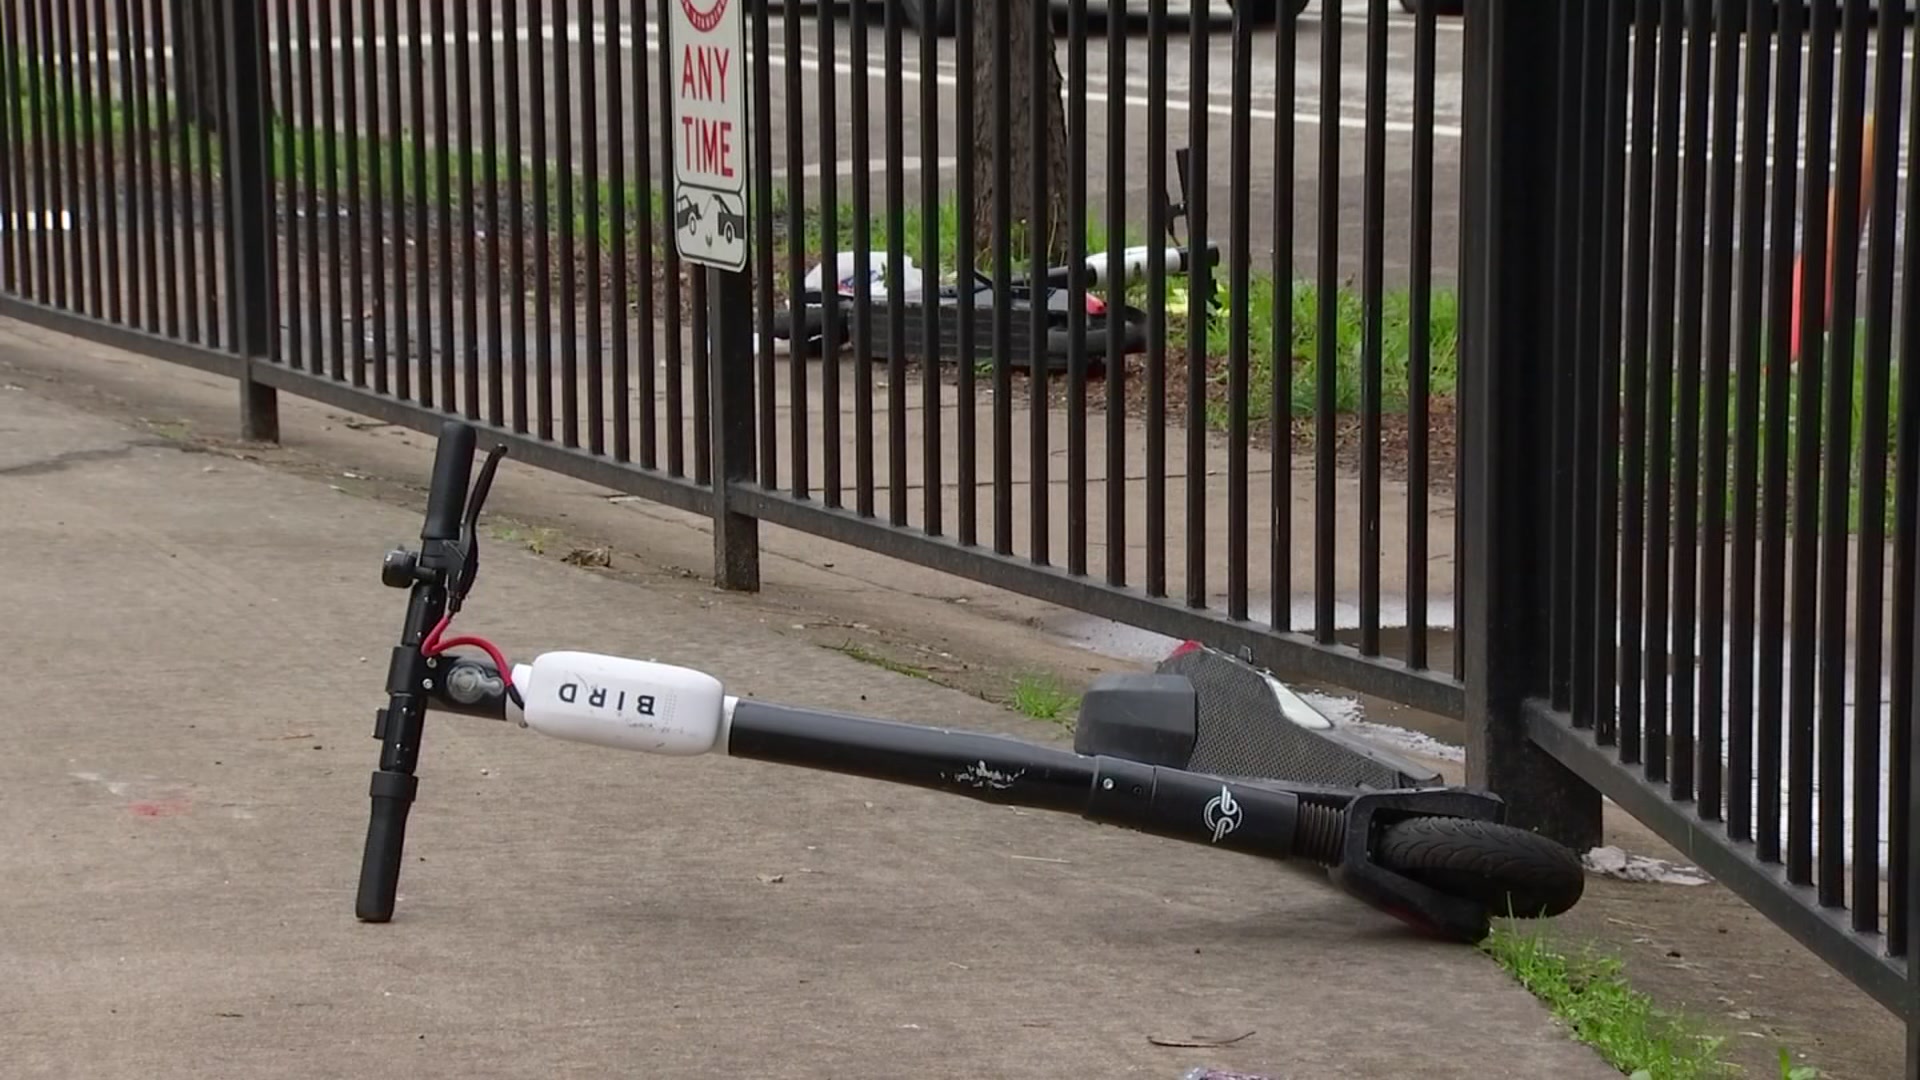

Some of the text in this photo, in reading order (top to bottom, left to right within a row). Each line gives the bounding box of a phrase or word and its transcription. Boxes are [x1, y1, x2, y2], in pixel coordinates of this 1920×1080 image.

[682, 44, 729, 103] ANY
[682, 116, 734, 178] TIME
[558, 682, 656, 717] BIRD
